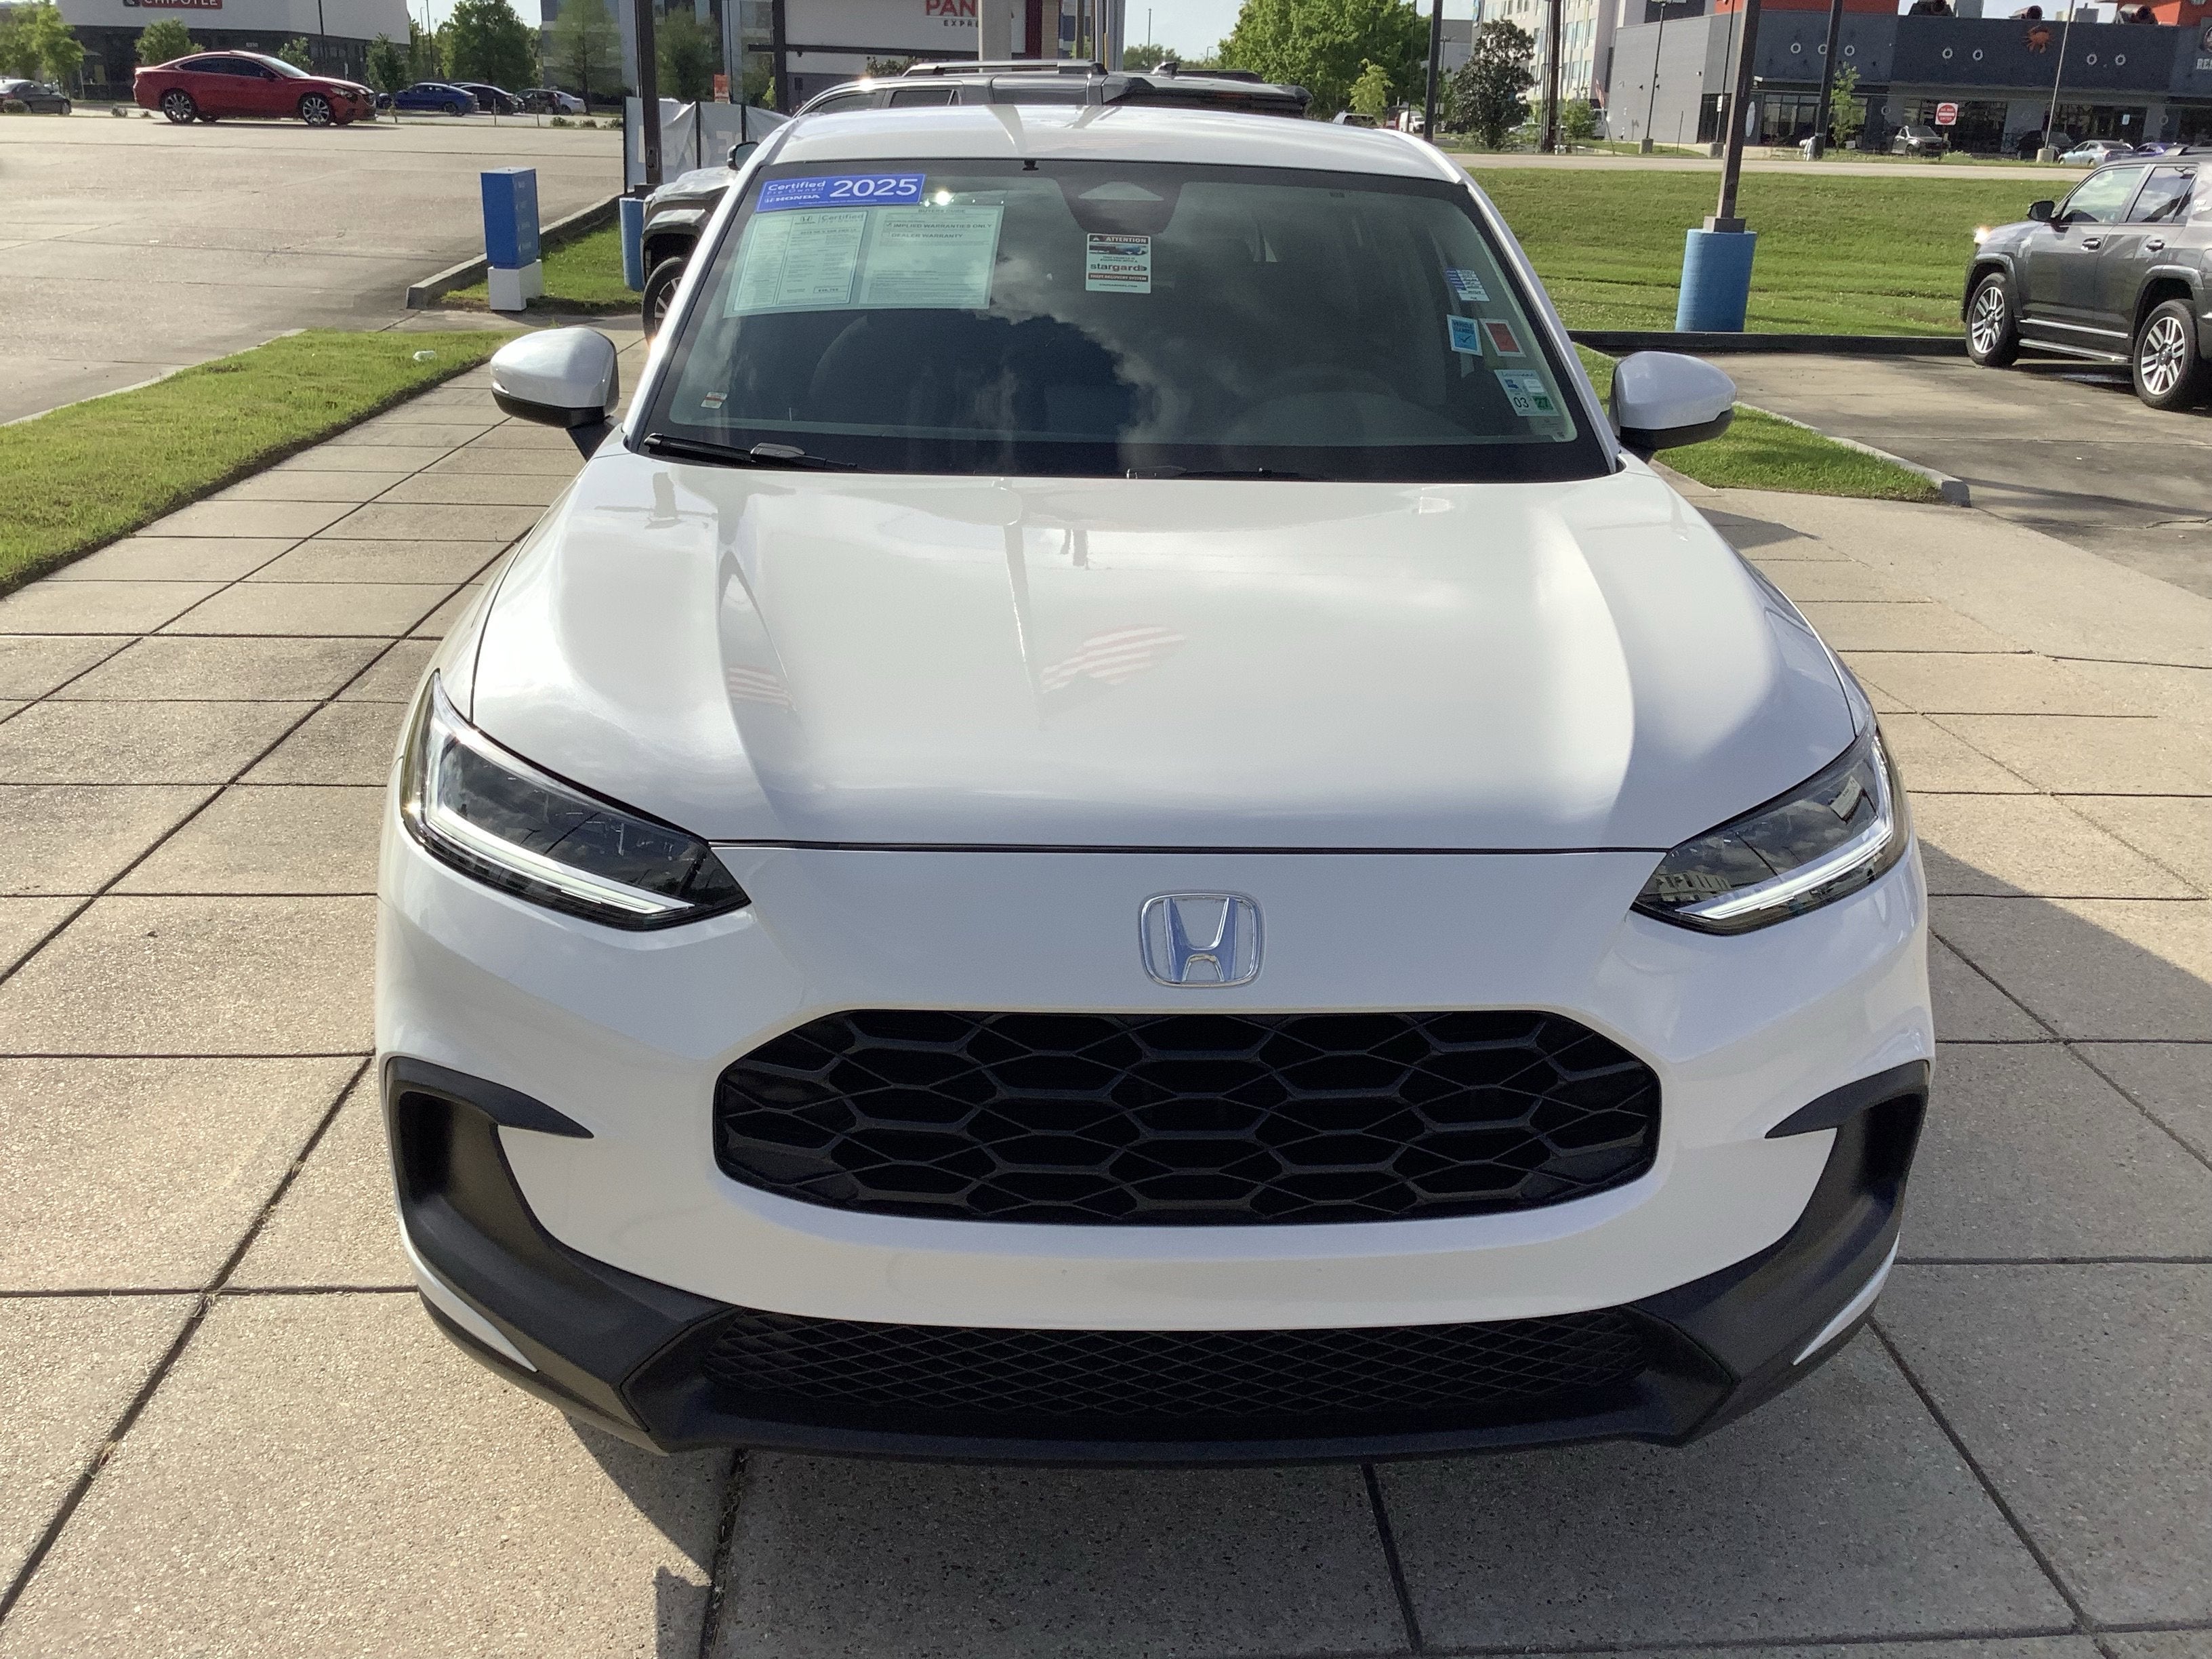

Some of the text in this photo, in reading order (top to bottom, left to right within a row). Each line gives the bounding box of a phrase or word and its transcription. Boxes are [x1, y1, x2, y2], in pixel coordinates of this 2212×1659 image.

[768, 178, 919, 198] Certified 2025
[774, 194, 820, 202] HONDA
[1090, 263, 1140, 272] stargard
[1513, 397, 1529, 408] 03
